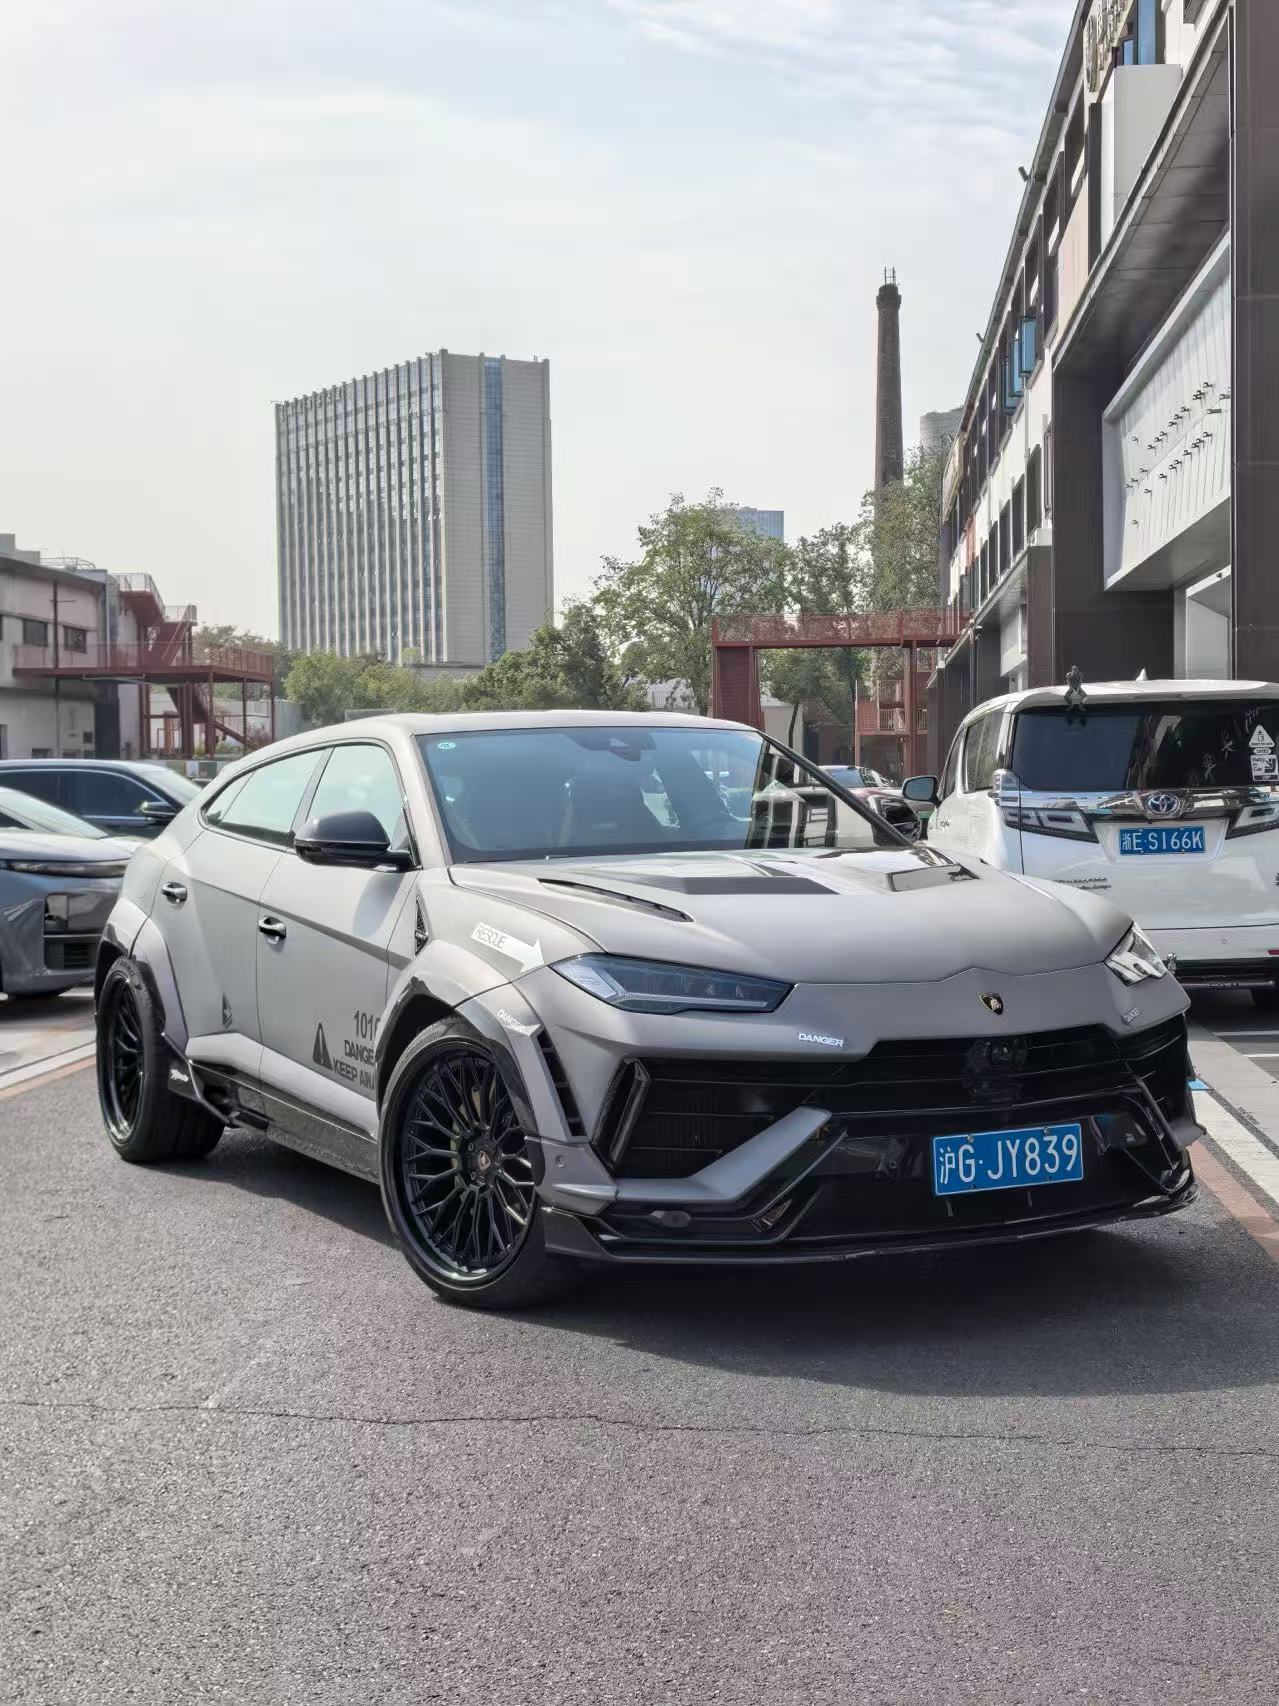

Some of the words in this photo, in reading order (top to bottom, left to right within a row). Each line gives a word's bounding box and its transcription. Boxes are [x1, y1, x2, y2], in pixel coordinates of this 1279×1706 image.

[1121, 830, 1203, 851] 浙E·S166K
[474, 924, 508, 949] RESCUE
[798, 1033, 844, 1047] DANGER
[344, 1040, 376, 1067] DANGE
[333, 1057, 358, 1082] KEEP
[359, 1068, 376, 1090] AW
[938, 1133, 1079, 1185] 沪G·JY839
